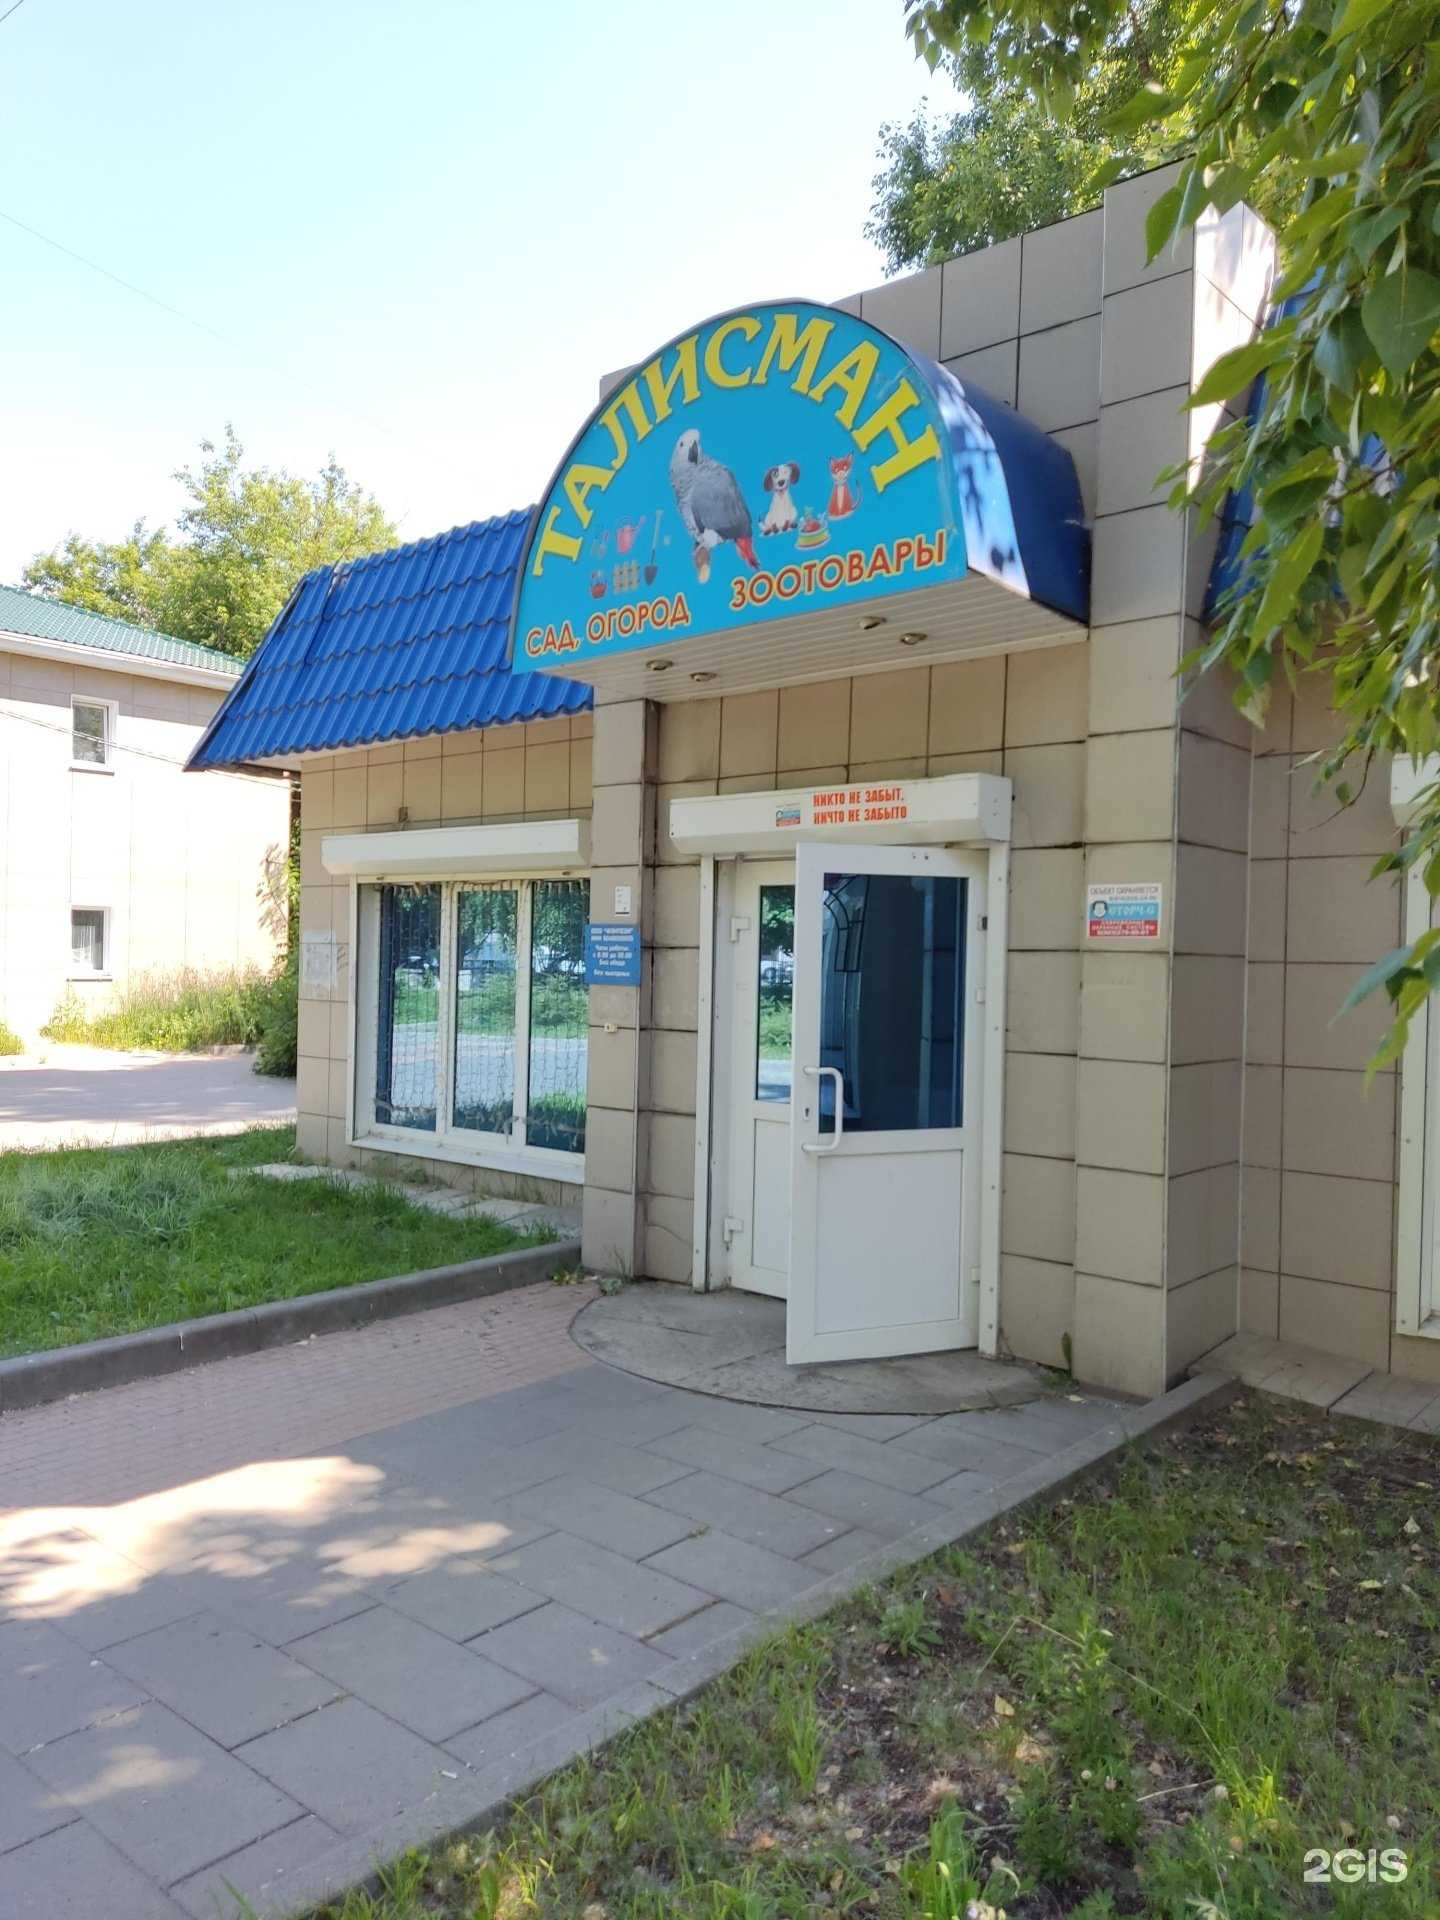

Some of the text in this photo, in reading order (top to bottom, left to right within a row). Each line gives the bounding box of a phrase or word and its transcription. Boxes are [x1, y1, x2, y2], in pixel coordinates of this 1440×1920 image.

[532, 313, 942, 577] ТАЛИСМАН
[730, 530, 946, 610] ЗООТОВАРЫ
[526, 594, 690, 657] САД, ОГОРОД
[813, 793, 845, 807] НИКТО
[849, 791, 861, 804] НЕ
[814, 811, 845, 824] НИЧТО
[849, 809, 860, 822] НЕ
[864, 806, 907, 822] ЗАБЫТО
